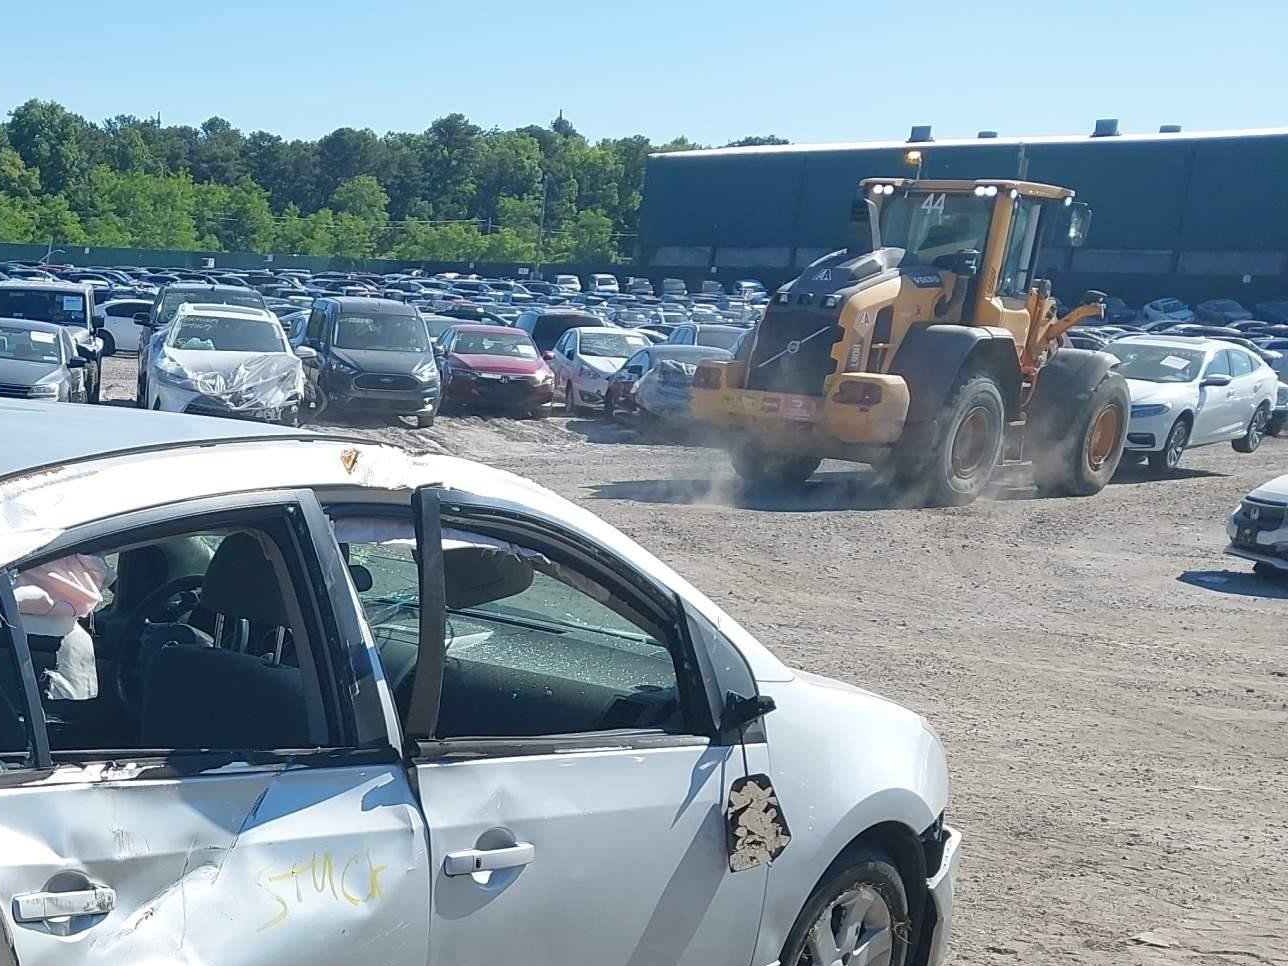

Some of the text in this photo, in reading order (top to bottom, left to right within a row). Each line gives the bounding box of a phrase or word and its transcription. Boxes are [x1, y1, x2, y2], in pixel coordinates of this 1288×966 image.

[920, 192, 946, 215] 44
[912, 276, 940, 285] VOLVO
[256, 850, 389, 933] STUCK
